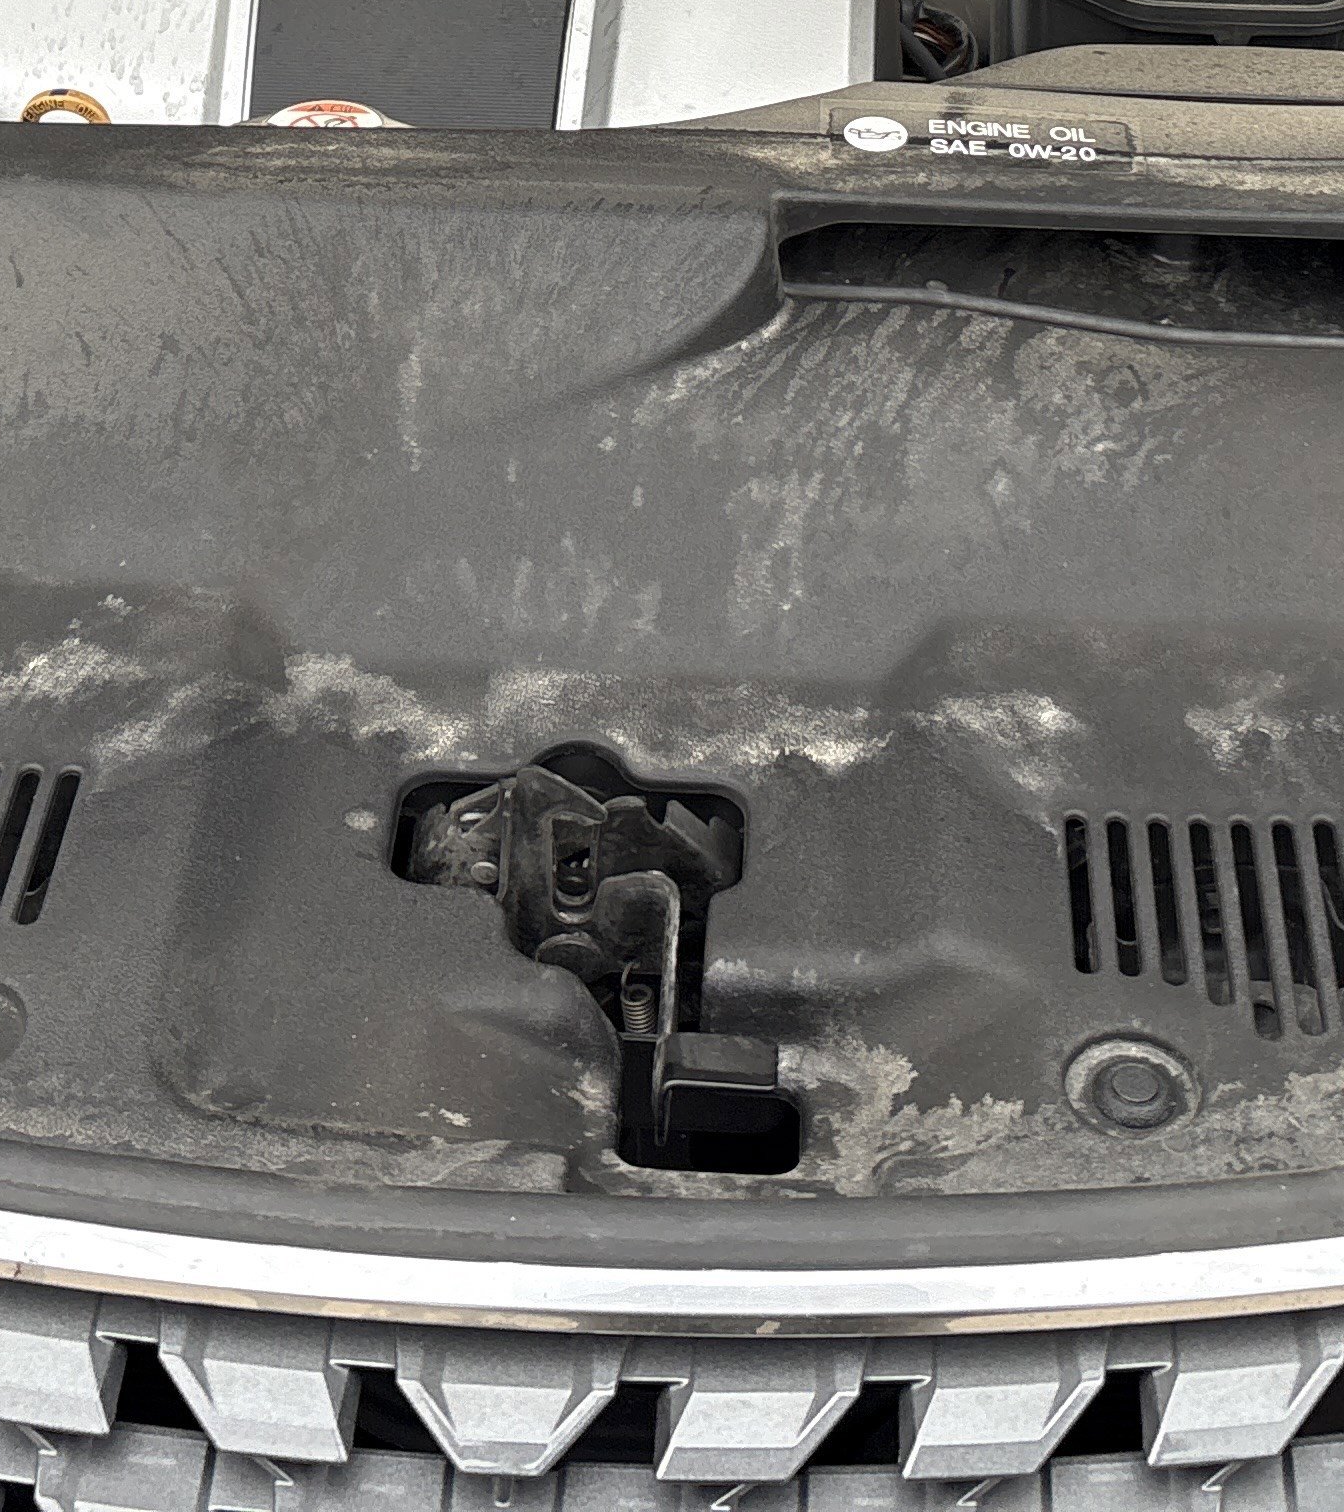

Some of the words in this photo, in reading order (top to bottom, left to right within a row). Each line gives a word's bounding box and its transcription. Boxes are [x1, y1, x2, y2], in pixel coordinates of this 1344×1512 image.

[928, 119, 1031, 139] ENGINE
[1049, 126, 1097, 143] OIL
[929, 138, 988, 156] SAE
[1008, 143, 1097, 162] 0W-20
